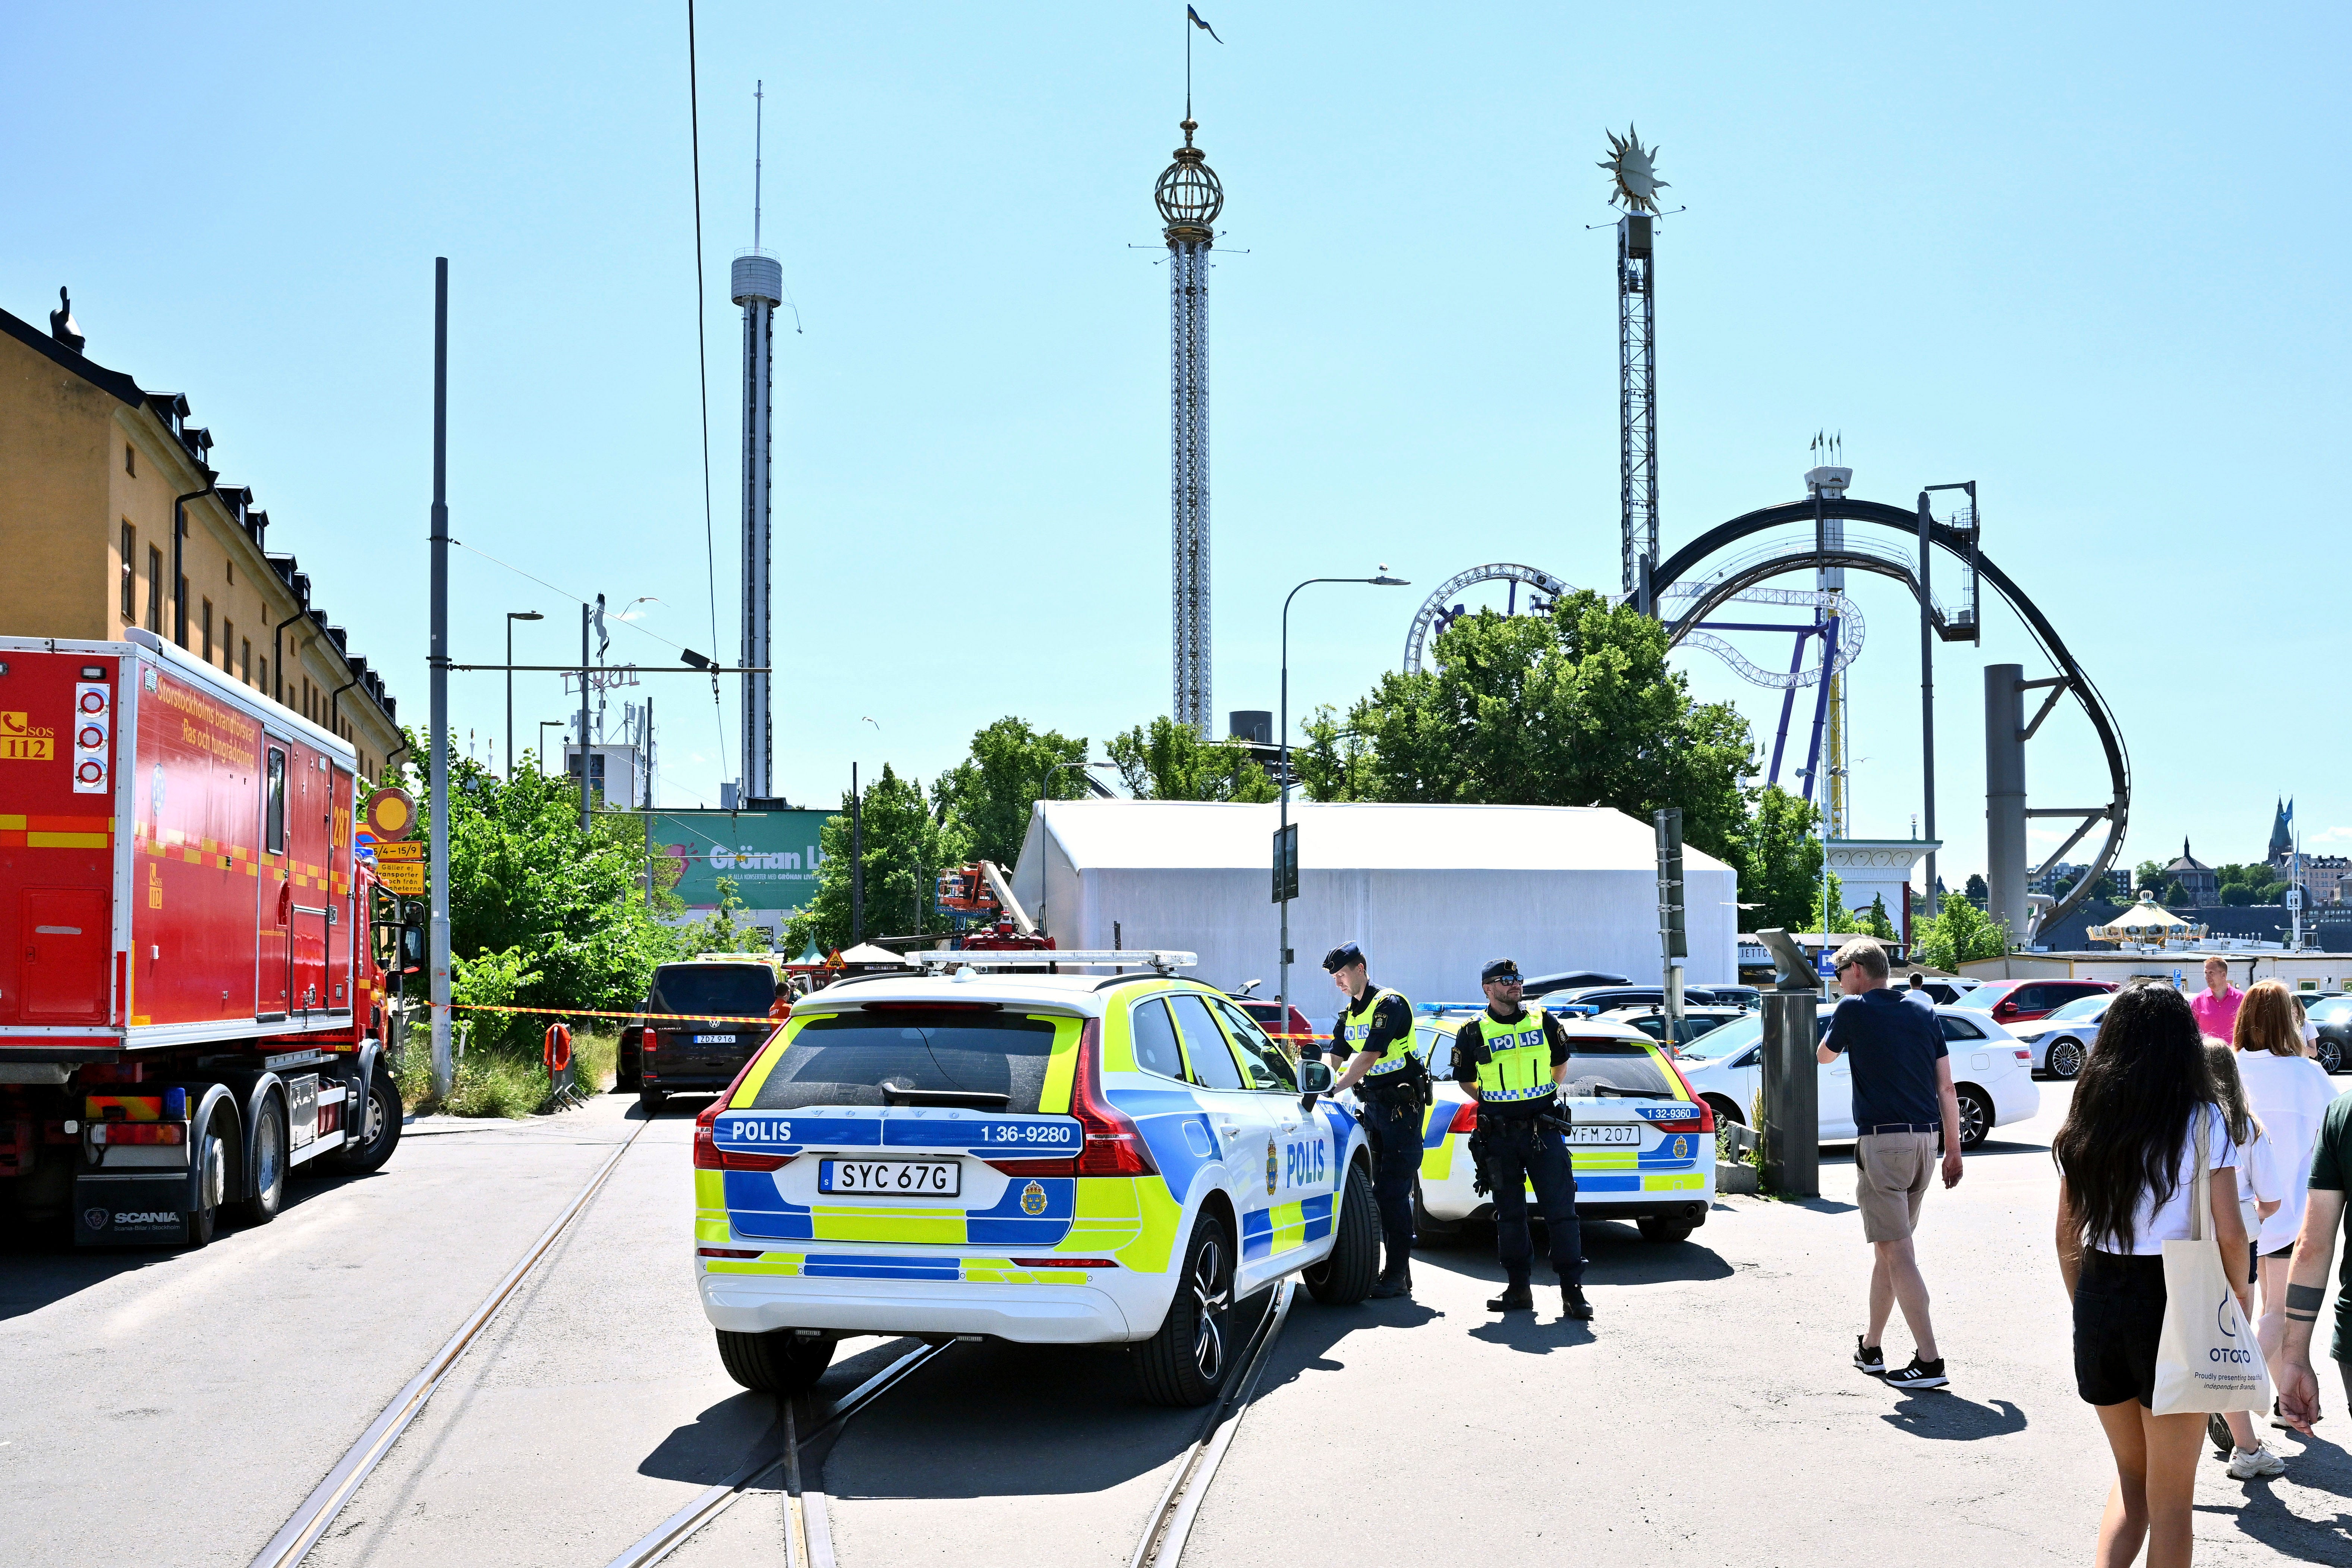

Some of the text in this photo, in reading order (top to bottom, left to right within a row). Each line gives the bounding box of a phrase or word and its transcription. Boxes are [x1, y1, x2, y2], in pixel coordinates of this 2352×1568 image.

[158, 676, 255, 743] Storstockholms brandförsvar
[28, 727, 54, 737] SOS
[7, 739, 46, 758] 112
[183, 718, 254, 774] Ras och tungräddning
[334, 806, 349, 848] 287
[374, 845, 388, 857] 5/4
[710, 845, 800, 869] Grönan
[151, 890, 160, 907] 112
[1738, 948, 1772, 958] JETTC
[1493, 1031, 1539, 1050] POLIS
[811, 1109, 959, 1119] VOLVO
[1648, 1108, 1691, 1118] 1 32-9360
[733, 1121, 791, 1141] POLIS
[981, 1126, 1070, 1142] 1 36-9280
[1605, 1128, 1632, 1142] 207
[1287, 1139, 1324, 1188] POLIS
[842, 1164, 946, 1190] SYC 67G
[114, 1212, 180, 1223] SCANIA
[2210, 1348, 2251, 1364] OTOTO
[2194, 1372, 2217, 1381] Proudly
[2204, 1382, 2239, 1391] independent
